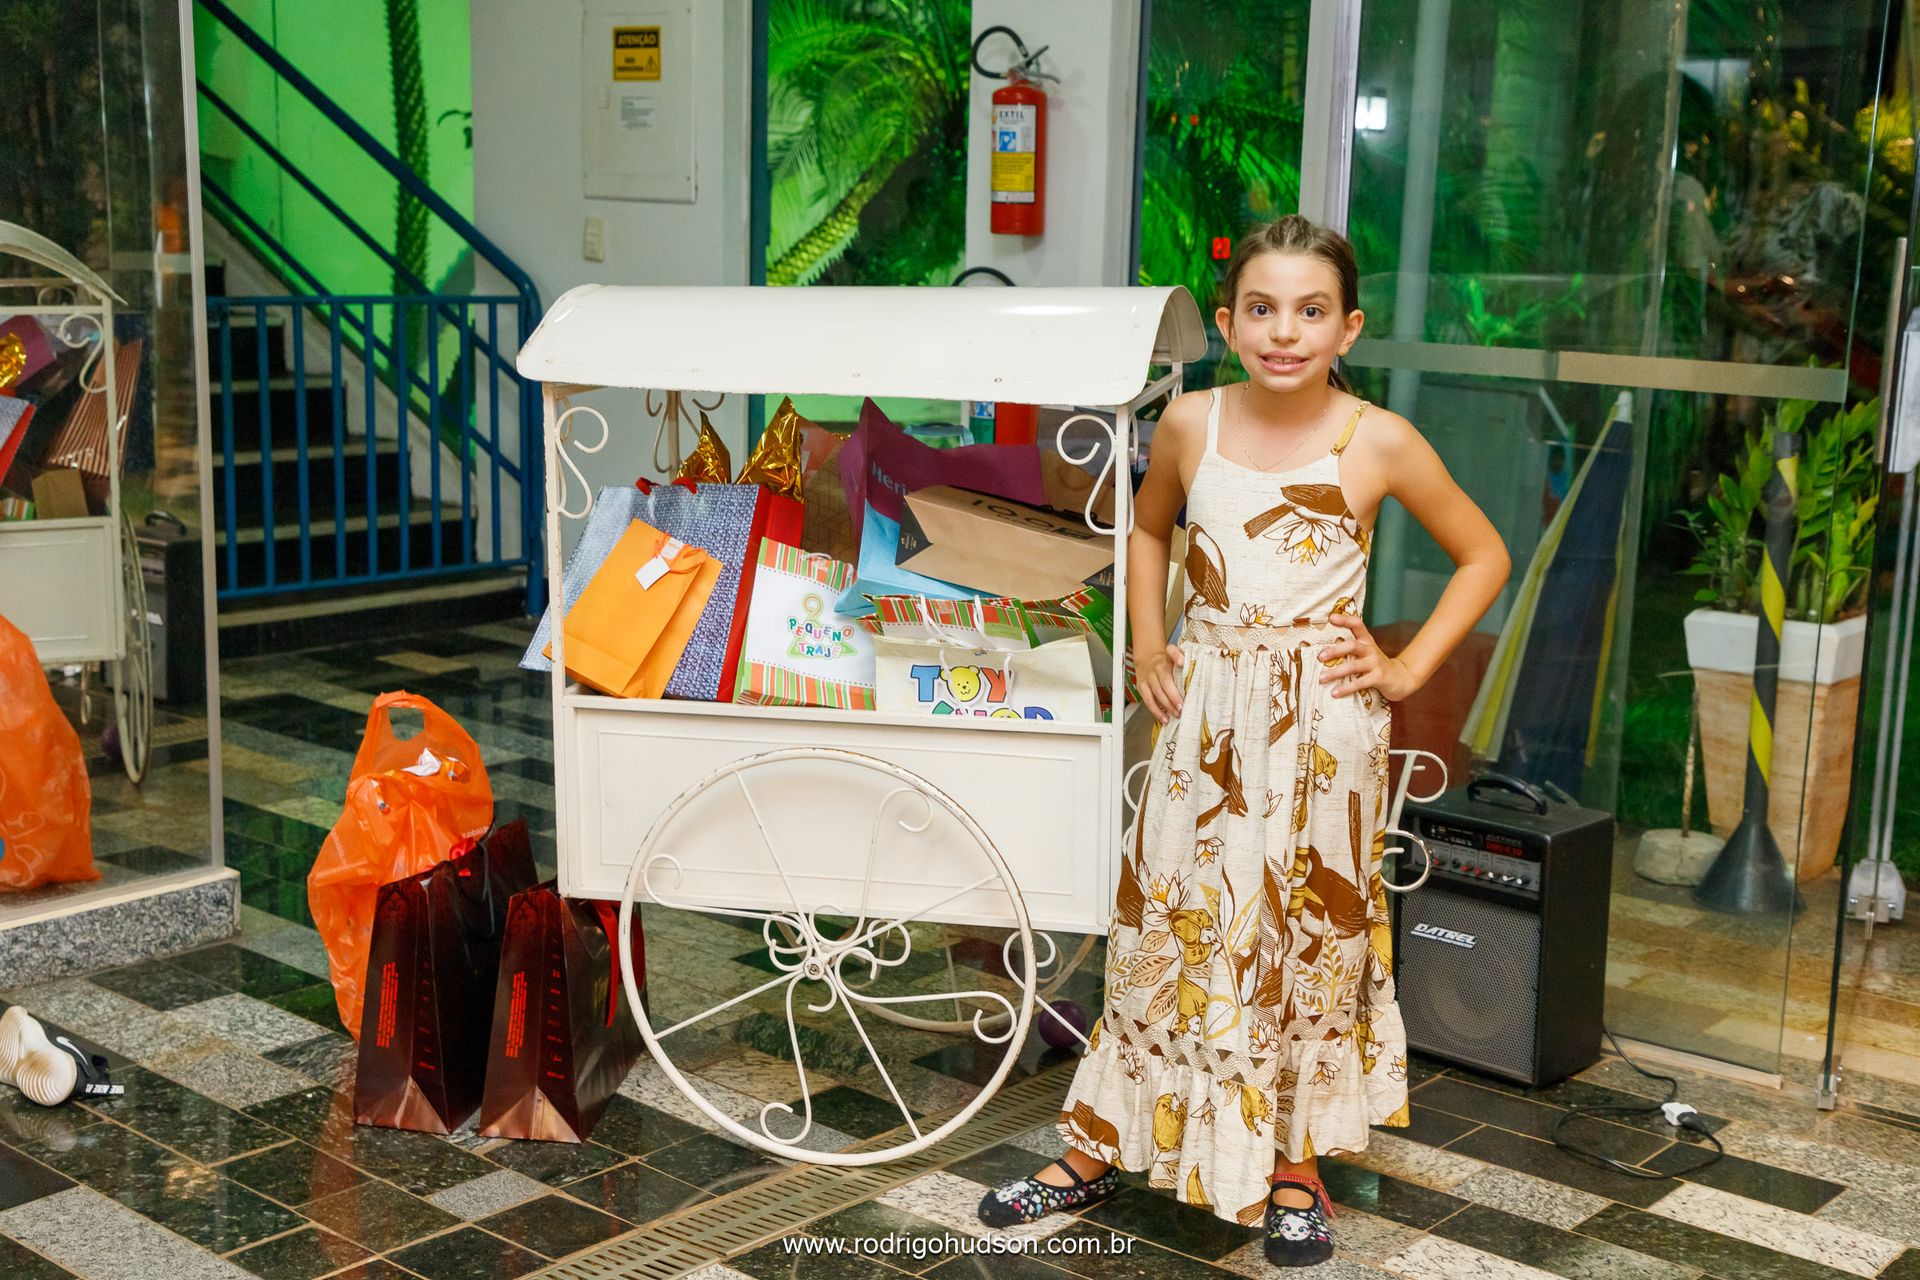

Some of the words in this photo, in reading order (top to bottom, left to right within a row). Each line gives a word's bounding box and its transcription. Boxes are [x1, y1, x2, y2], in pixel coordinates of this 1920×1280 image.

[618, 32, 656, 47] ATENÇÃO
[788, 617, 853, 642] PEQUENO
[1413, 922, 1477, 946] DATREL
